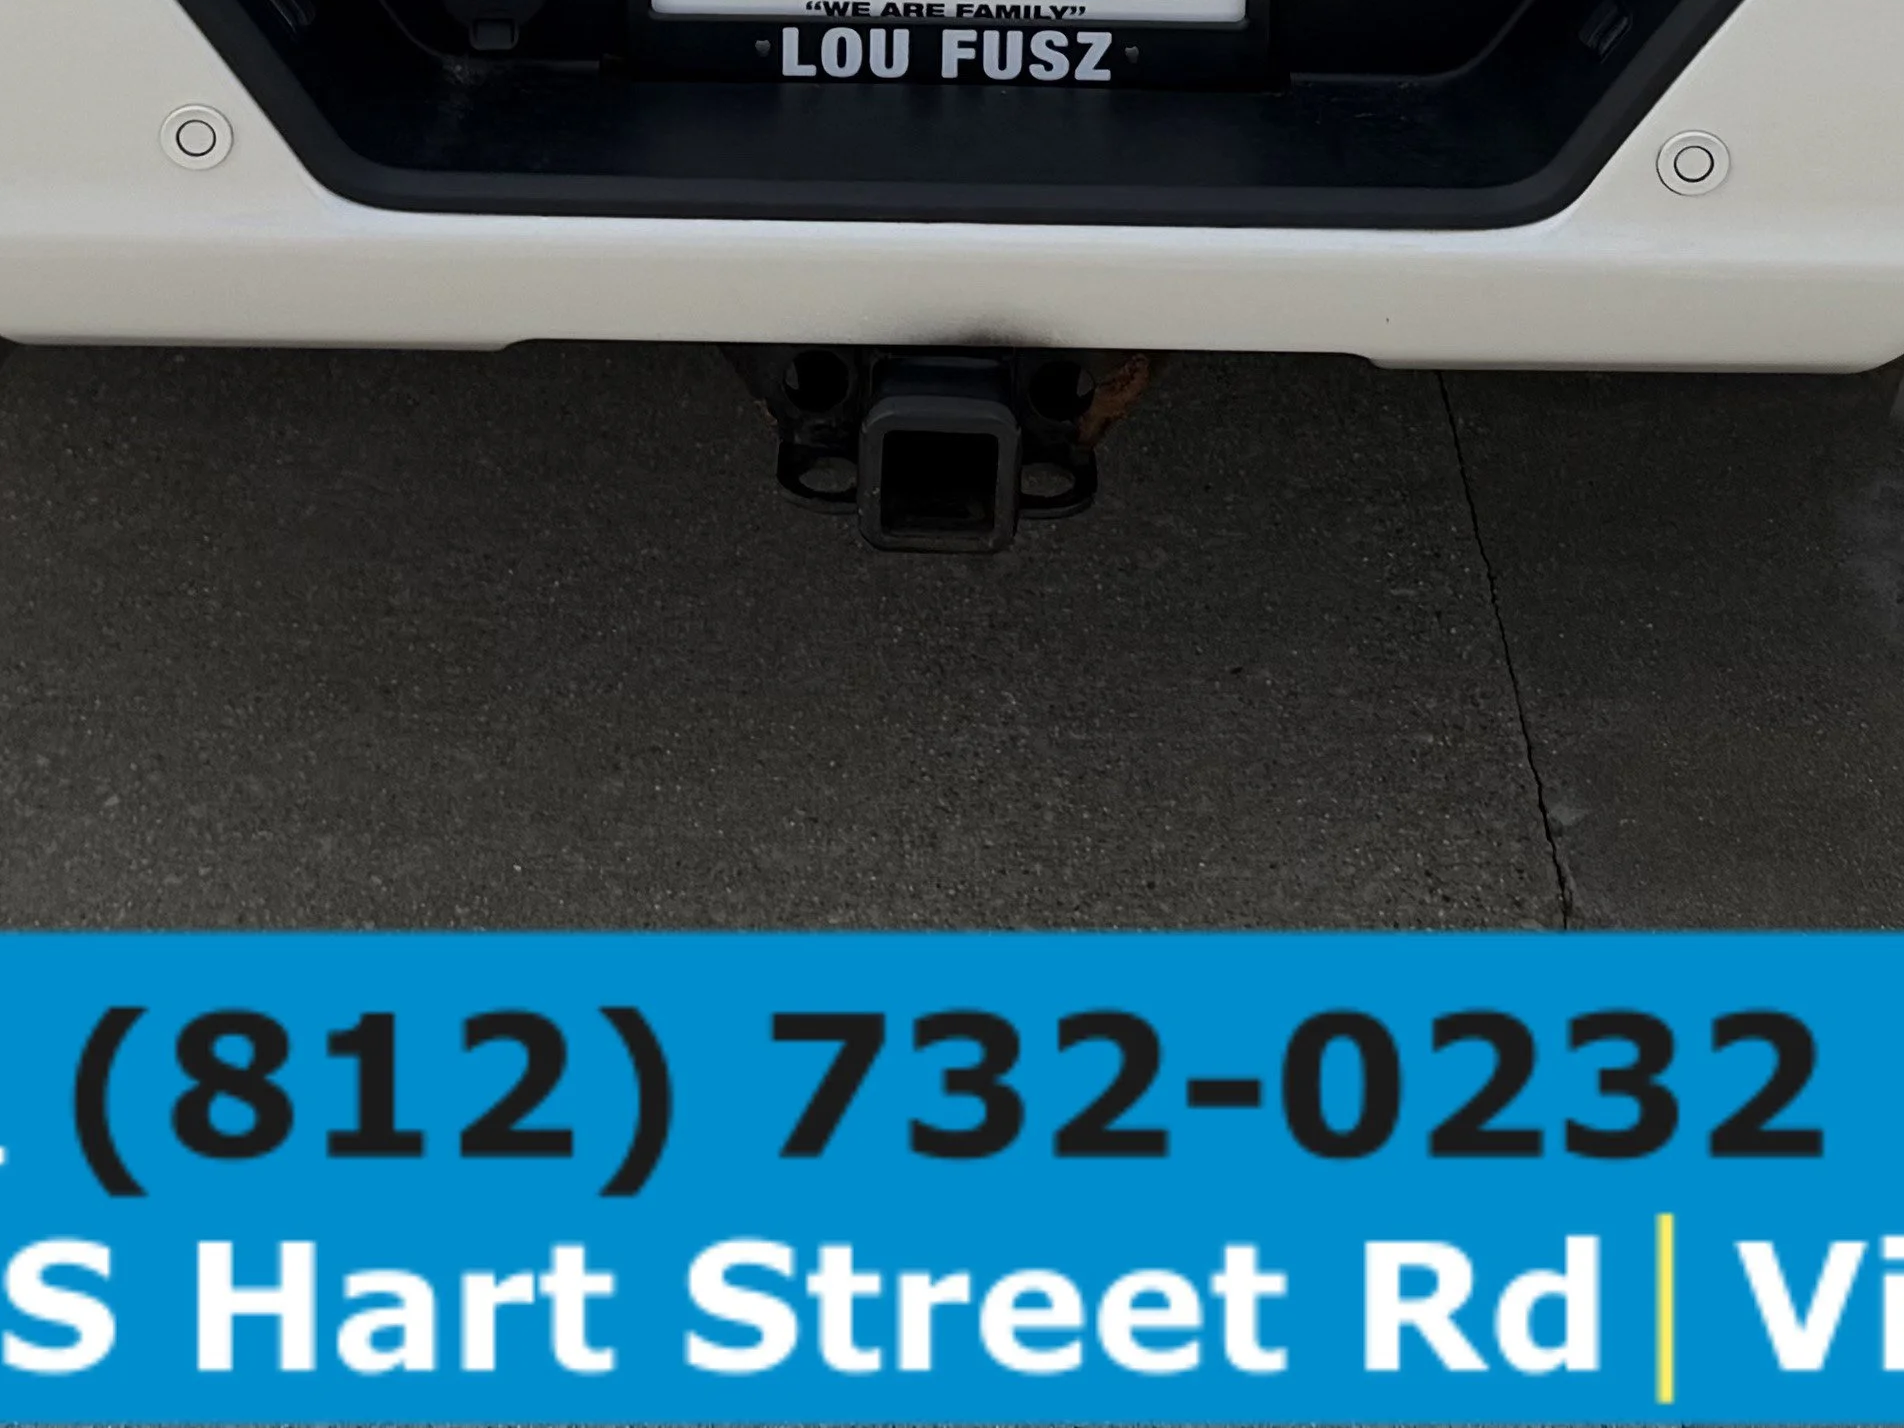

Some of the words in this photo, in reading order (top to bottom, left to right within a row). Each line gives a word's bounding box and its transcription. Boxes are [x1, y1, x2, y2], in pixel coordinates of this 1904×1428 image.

[880, 2, 945, 19] ARE
[781, 26, 910, 79] LOU
[941, 28, 1113, 83] FUSZ
